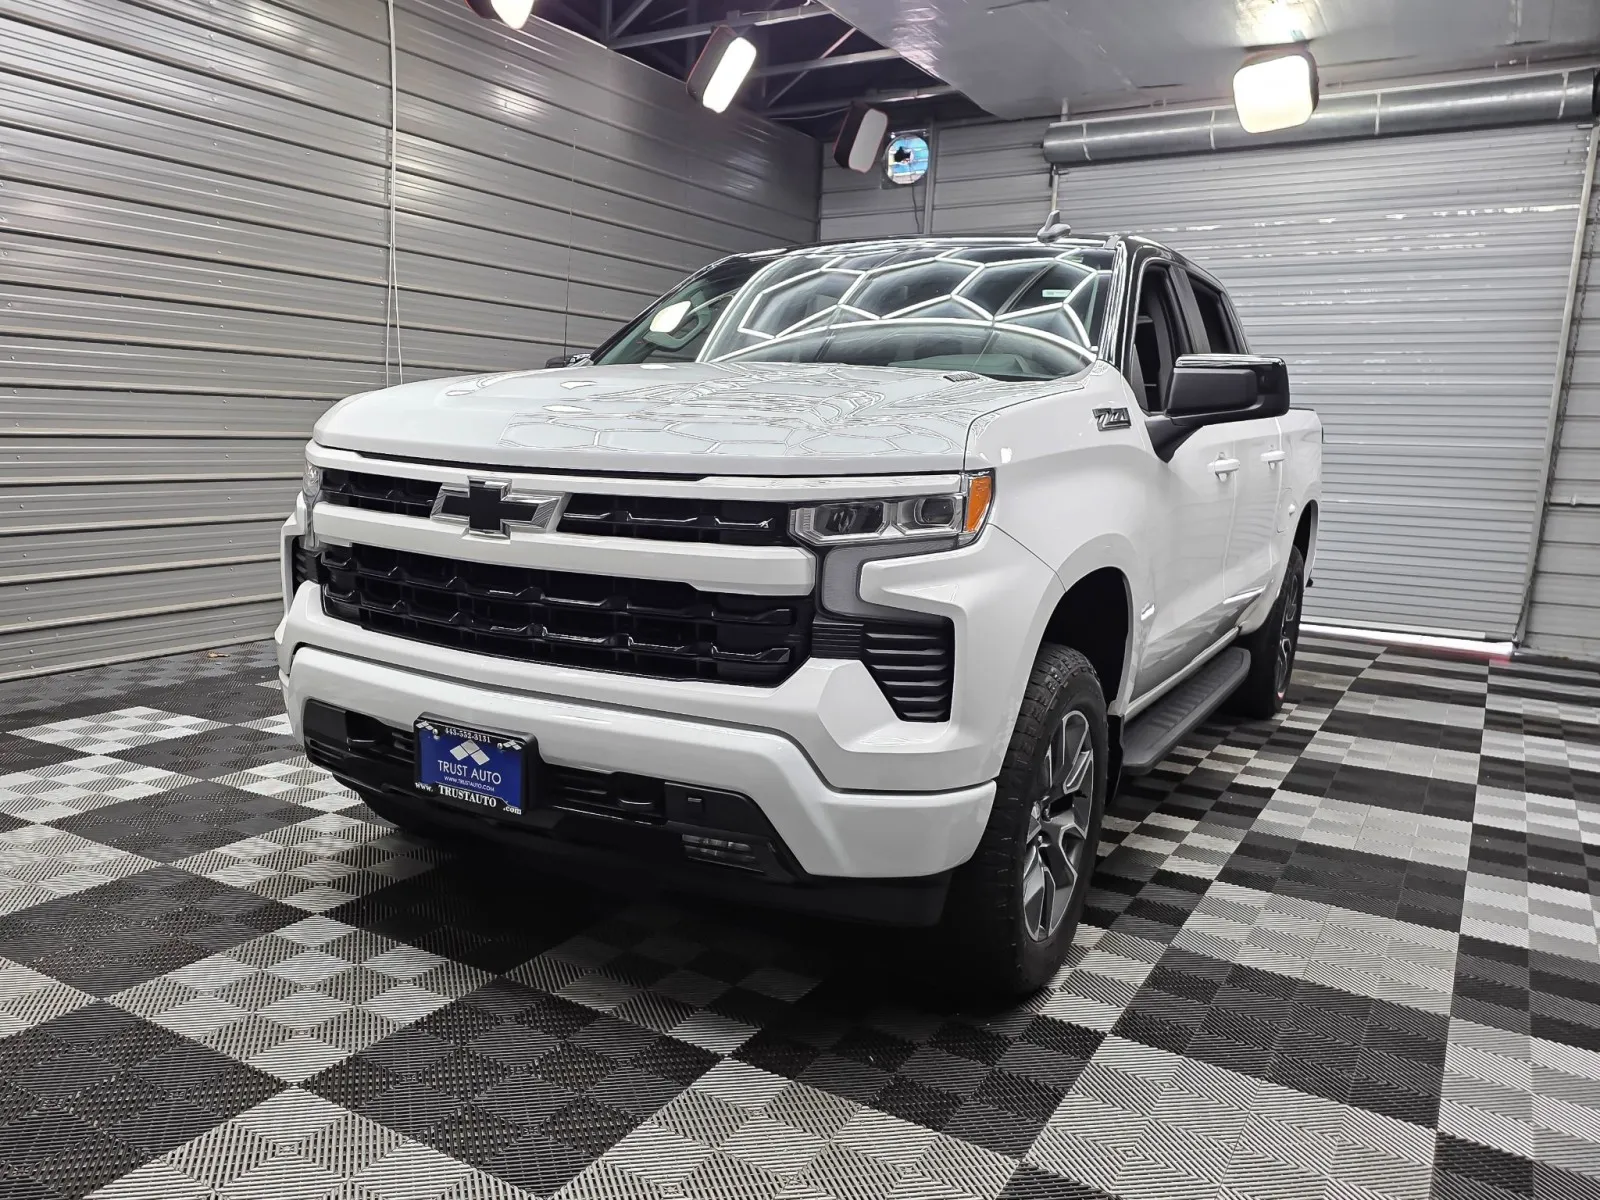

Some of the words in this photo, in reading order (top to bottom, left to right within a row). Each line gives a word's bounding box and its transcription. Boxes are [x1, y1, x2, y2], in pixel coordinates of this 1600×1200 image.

[445, 727, 491, 743] 443-552-3131
[437, 759, 468, 777] TRUST
[470, 768, 502, 785] AUTO
[437, 785, 497, 807] TRUSTAUTO
[503, 805, 522, 815] .com
